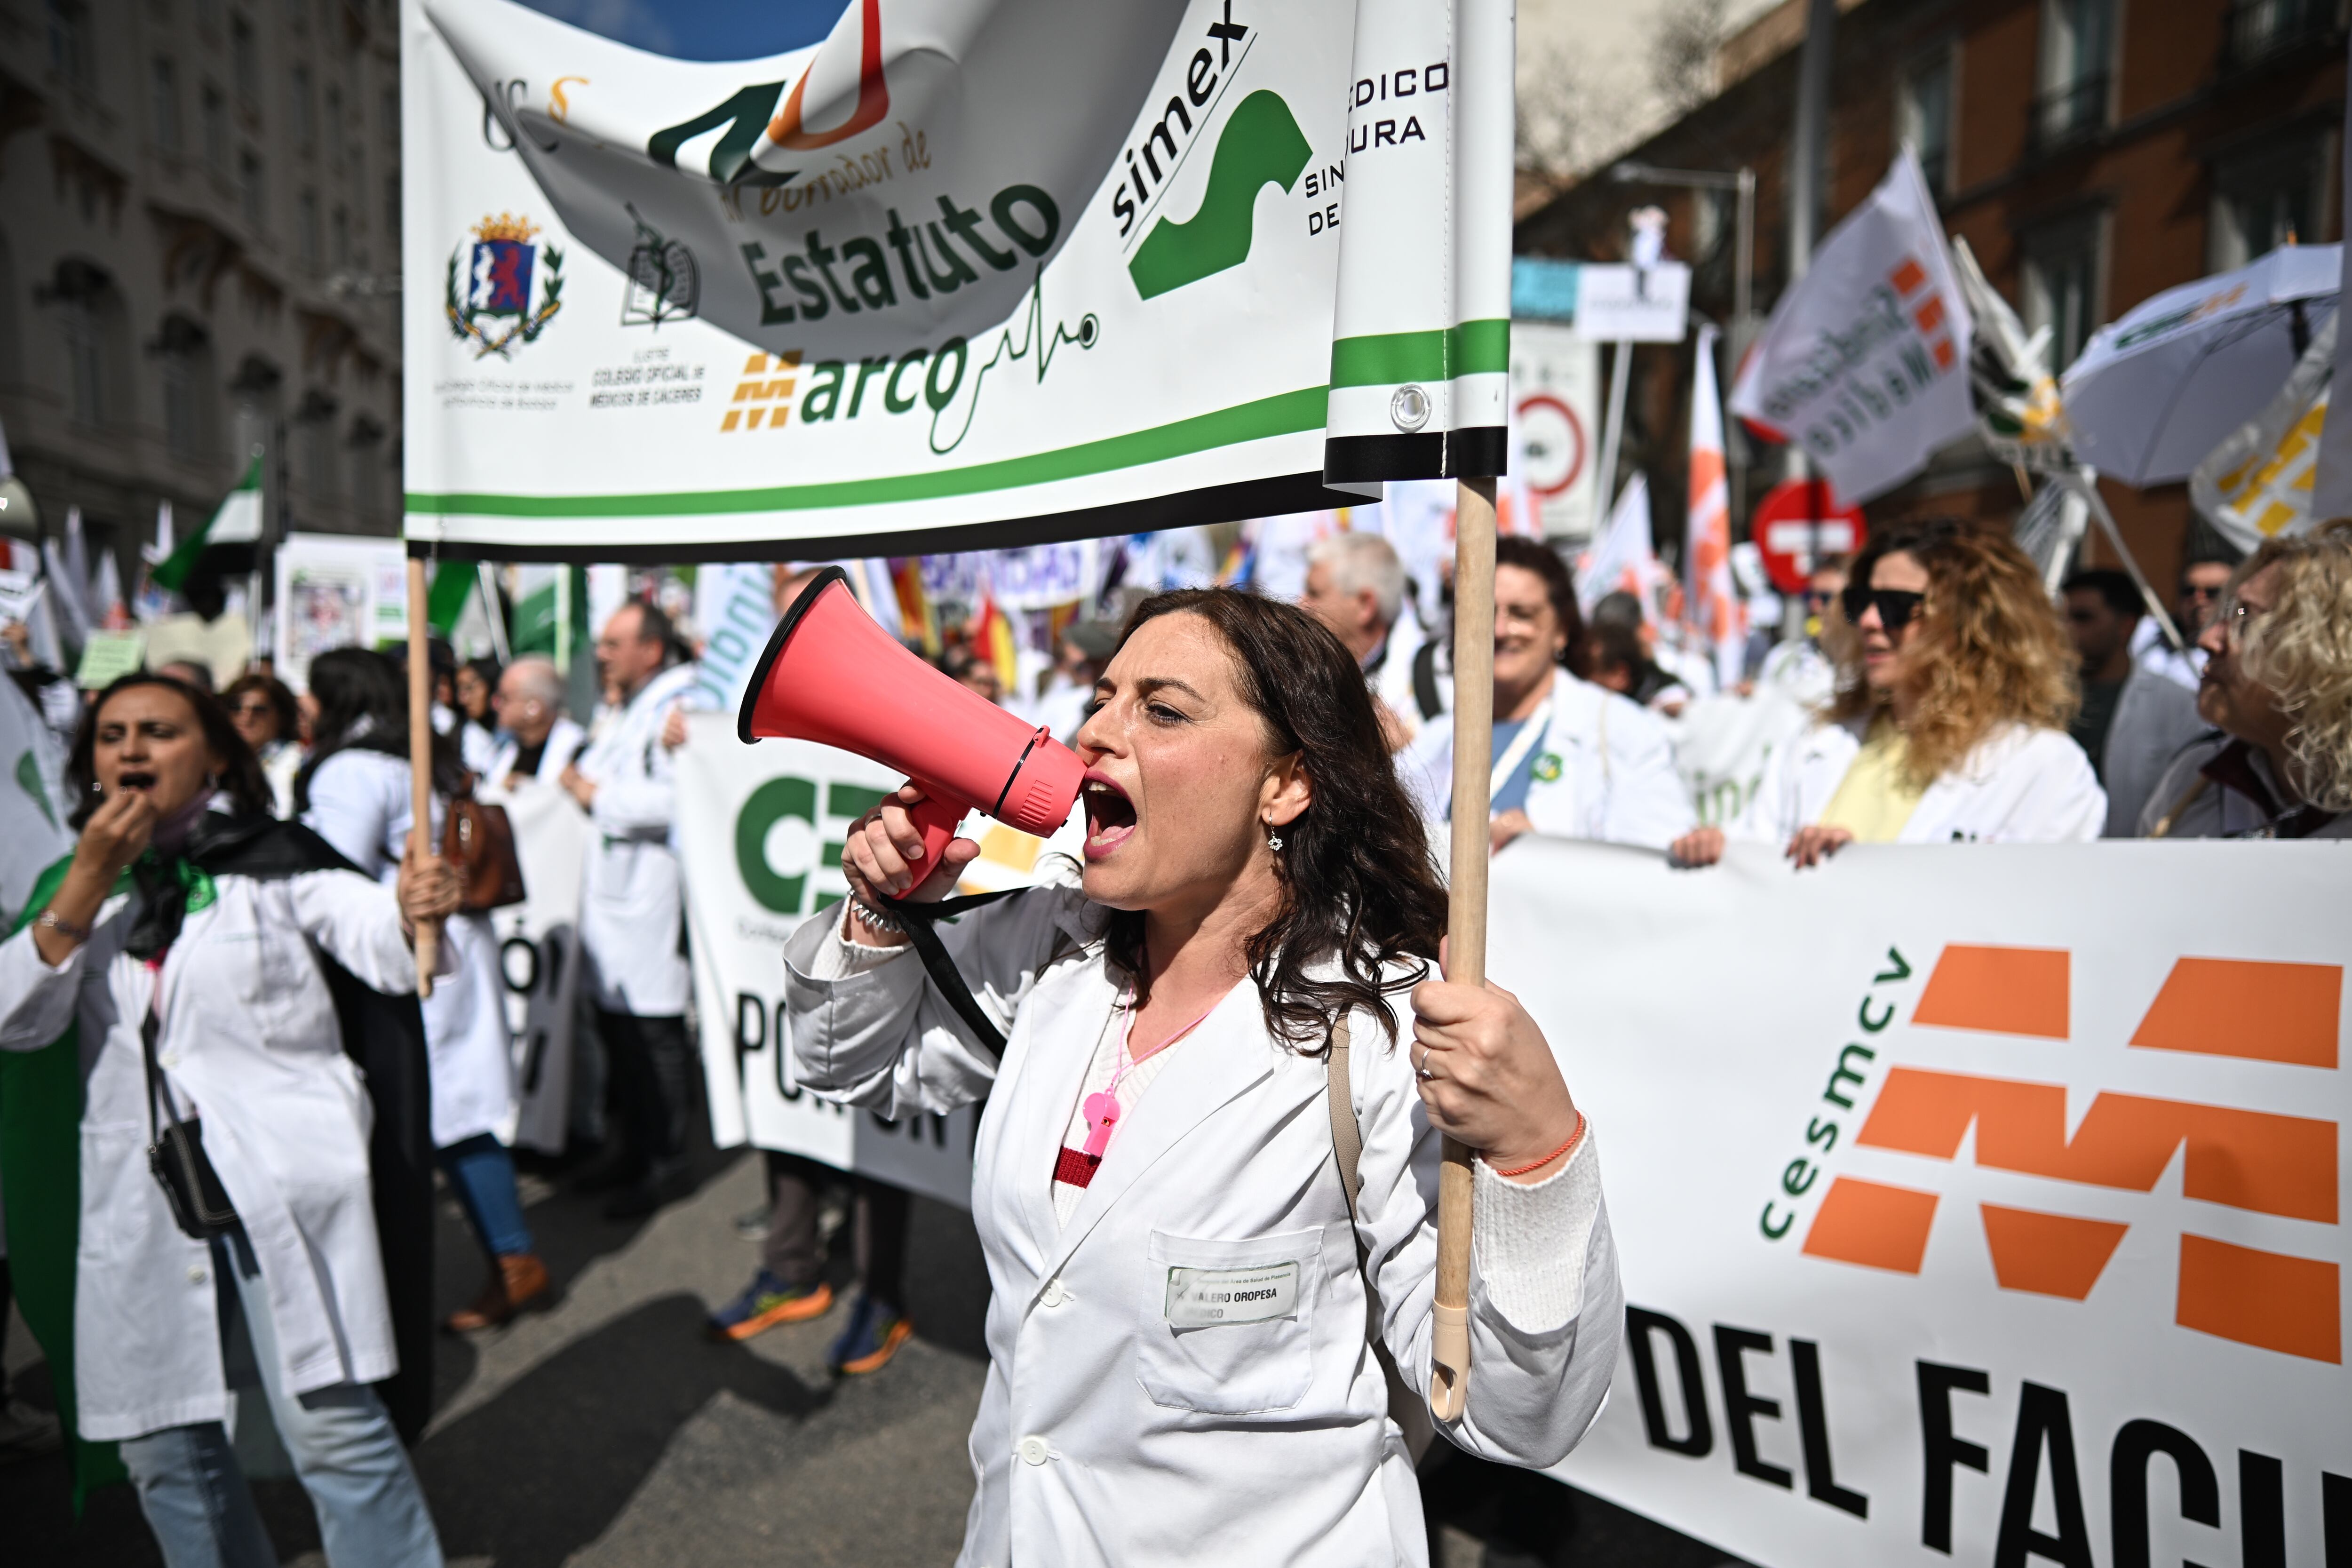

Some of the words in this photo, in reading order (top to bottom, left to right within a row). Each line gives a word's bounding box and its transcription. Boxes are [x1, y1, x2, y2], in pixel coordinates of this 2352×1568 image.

[1113, 0, 1249, 239] simex
[1348, 62, 1449, 113] DICO
[760, 146, 893, 216] borrador
[897, 120, 932, 173] de
[1345, 116, 1426, 159] URA
[739, 184, 1060, 326] Estatuto
[1308, 202, 1340, 236] DE
[720, 335, 968, 432] Marco
[1759, 944, 1913, 1242] cesmcv
[1234, 1288, 1277, 1302] OROPESA
[1626, 1305, 1868, 1521] DEL
